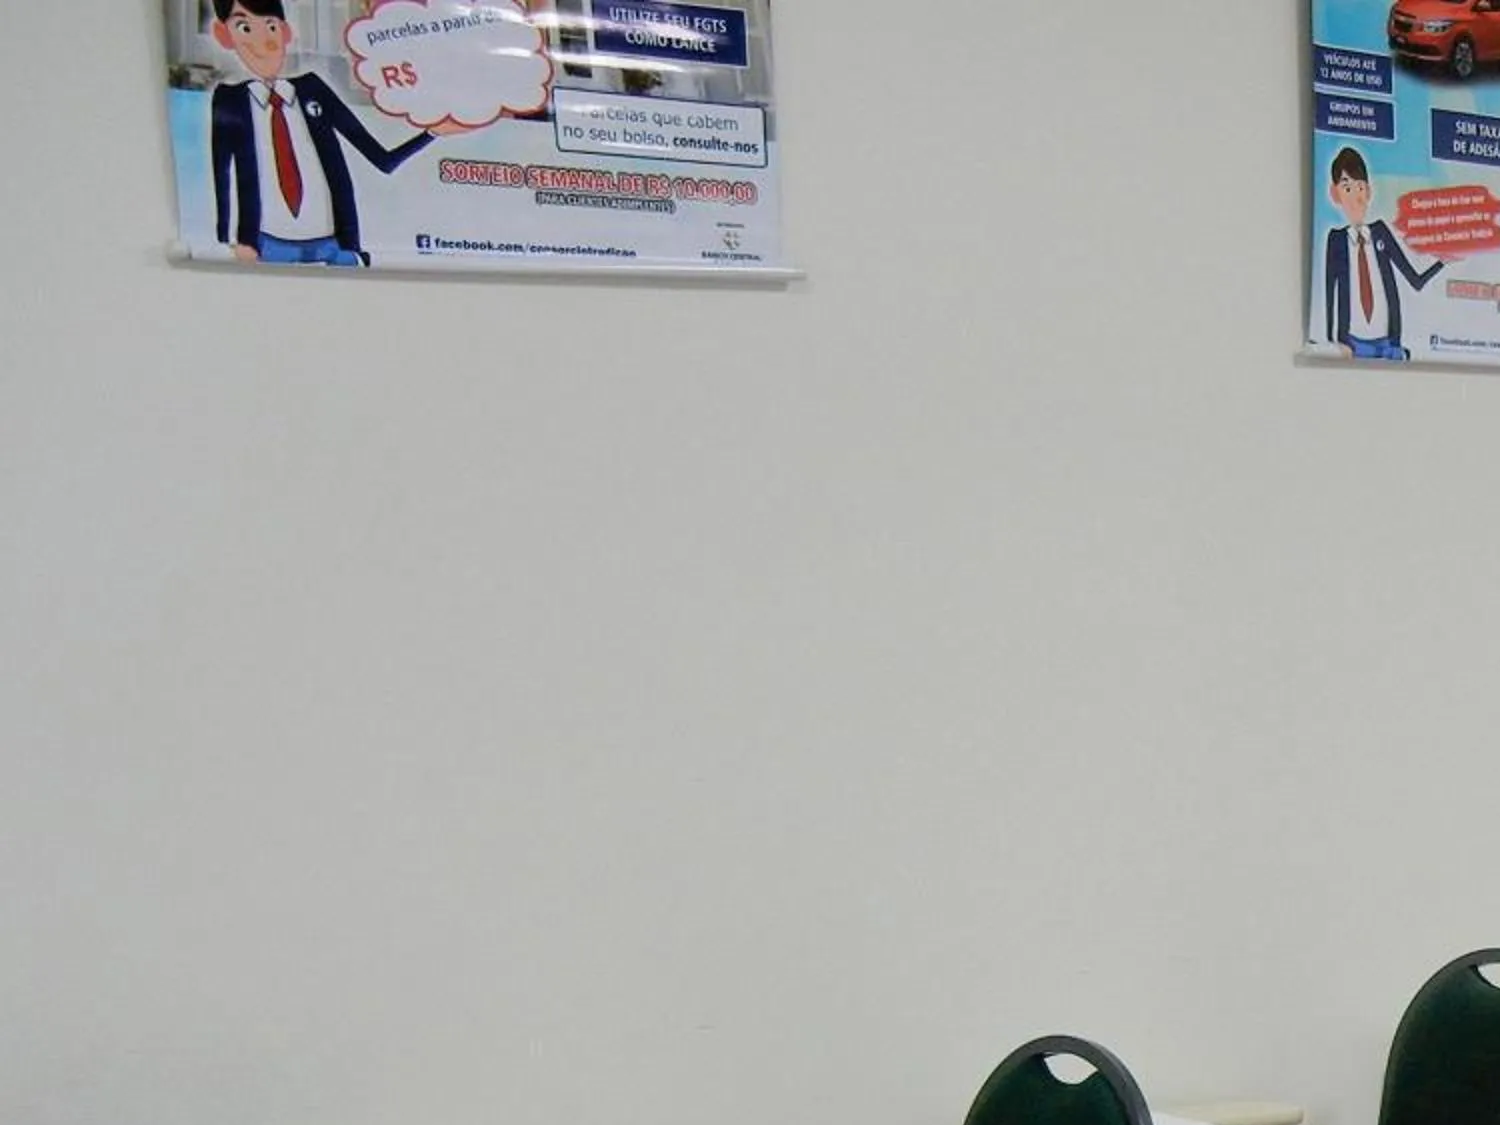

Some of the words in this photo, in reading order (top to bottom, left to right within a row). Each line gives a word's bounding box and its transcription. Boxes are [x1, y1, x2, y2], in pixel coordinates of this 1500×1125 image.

[366, 21, 430, 47] parcelas
[431, 20, 442, 34] a
[609, 6, 661, 24] UTILIZE
[693, 16, 728, 34] FGTS
[625, 29, 668, 48] COMO
[669, 34, 717, 53] LANCE
[381, 61, 418, 89] R$
[579, 105, 648, 123] arcelas
[651, 113, 684, 128] que
[687, 114, 739, 131] cabem
[1455, 119, 1477, 136] SEM
[562, 124, 585, 140] no
[588, 127, 618, 142] seu
[623, 129, 670, 148] bolso,
[672, 135, 760, 155] consulte-nos
[1453, 139, 1467, 154] DE
[440, 160, 526, 187] SORTEIO
[526, 166, 617, 196] SEMANAL
[618, 173, 644, 196] DE
